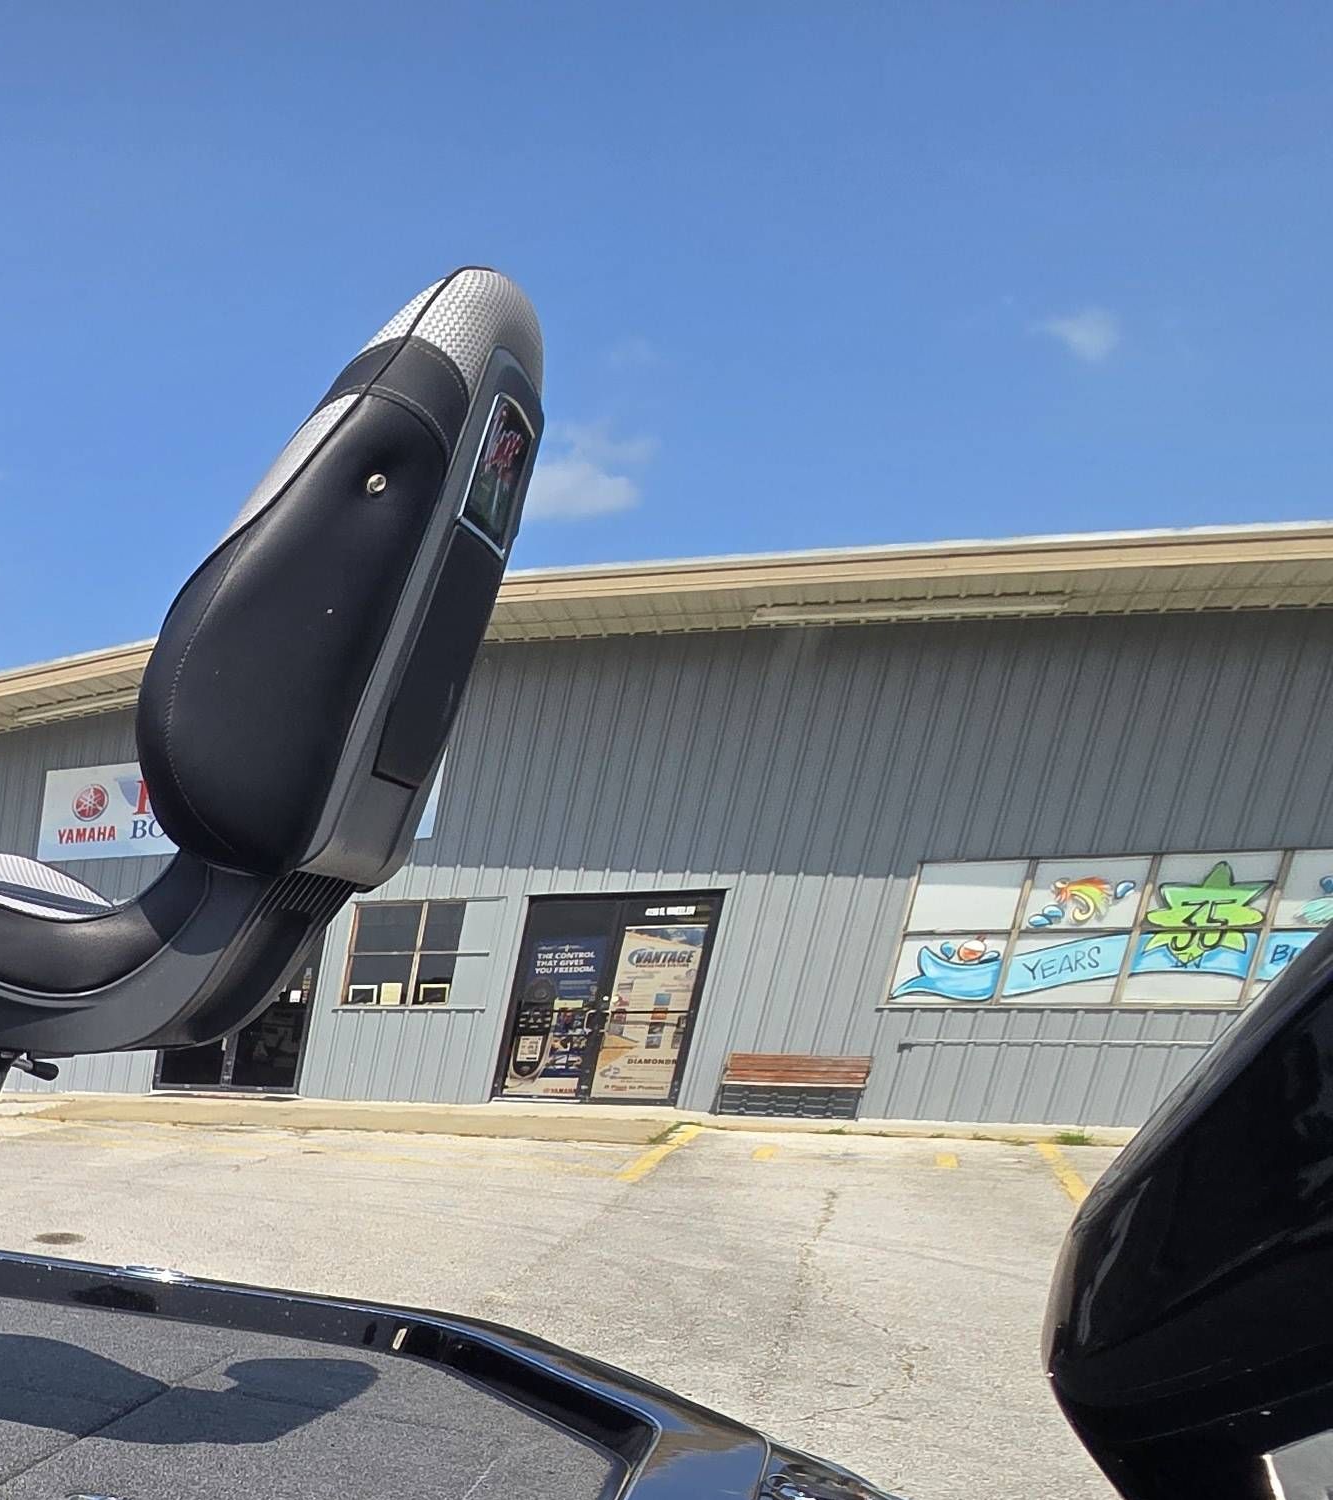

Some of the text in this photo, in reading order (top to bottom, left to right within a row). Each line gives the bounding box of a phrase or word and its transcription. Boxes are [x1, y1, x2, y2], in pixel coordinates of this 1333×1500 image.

[58, 825, 117, 844] YAMAHA
[537, 951, 596, 960] THE CONTROL
[634, 950, 696, 965] VANTAGE
[1021, 945, 1101, 981] YEARS
[534, 967, 552, 975] YOU
